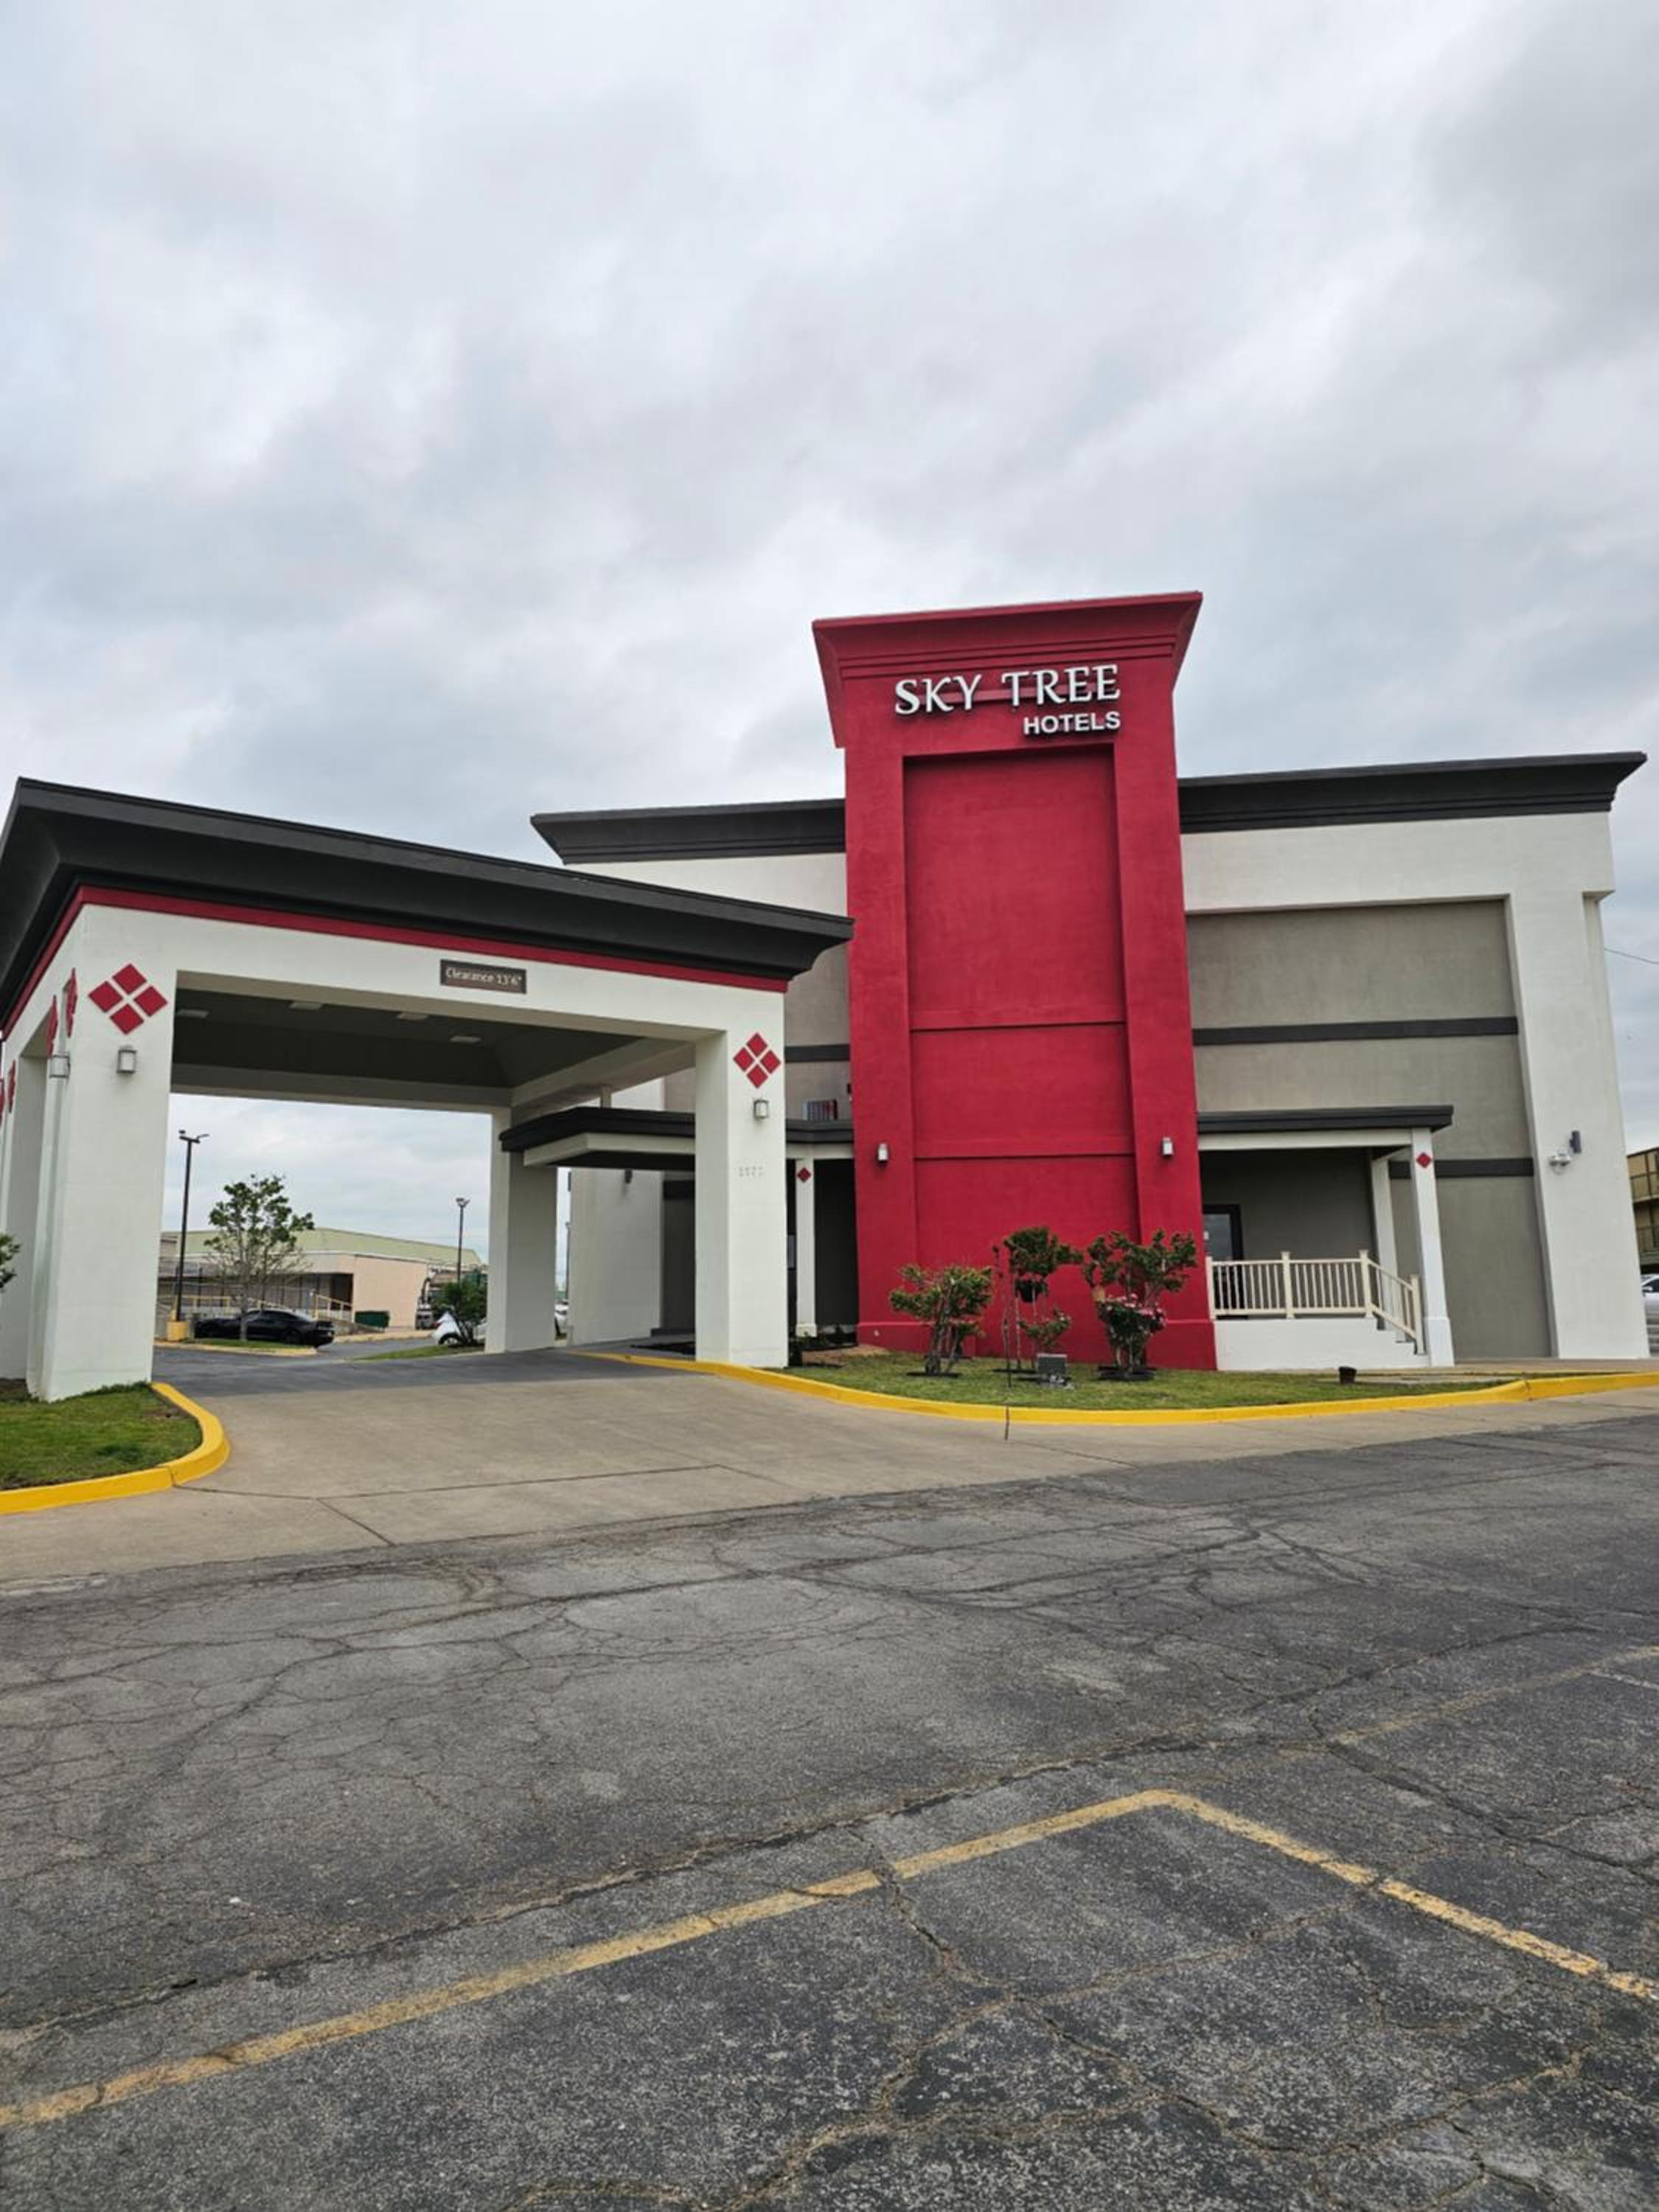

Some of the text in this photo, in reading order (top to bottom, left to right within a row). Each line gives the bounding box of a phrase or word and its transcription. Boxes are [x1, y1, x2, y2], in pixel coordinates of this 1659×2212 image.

[894, 664, 1121, 715] SKY TREE
[1023, 712, 1121, 735] HOTELS
[445, 967, 495, 983] Clearance
